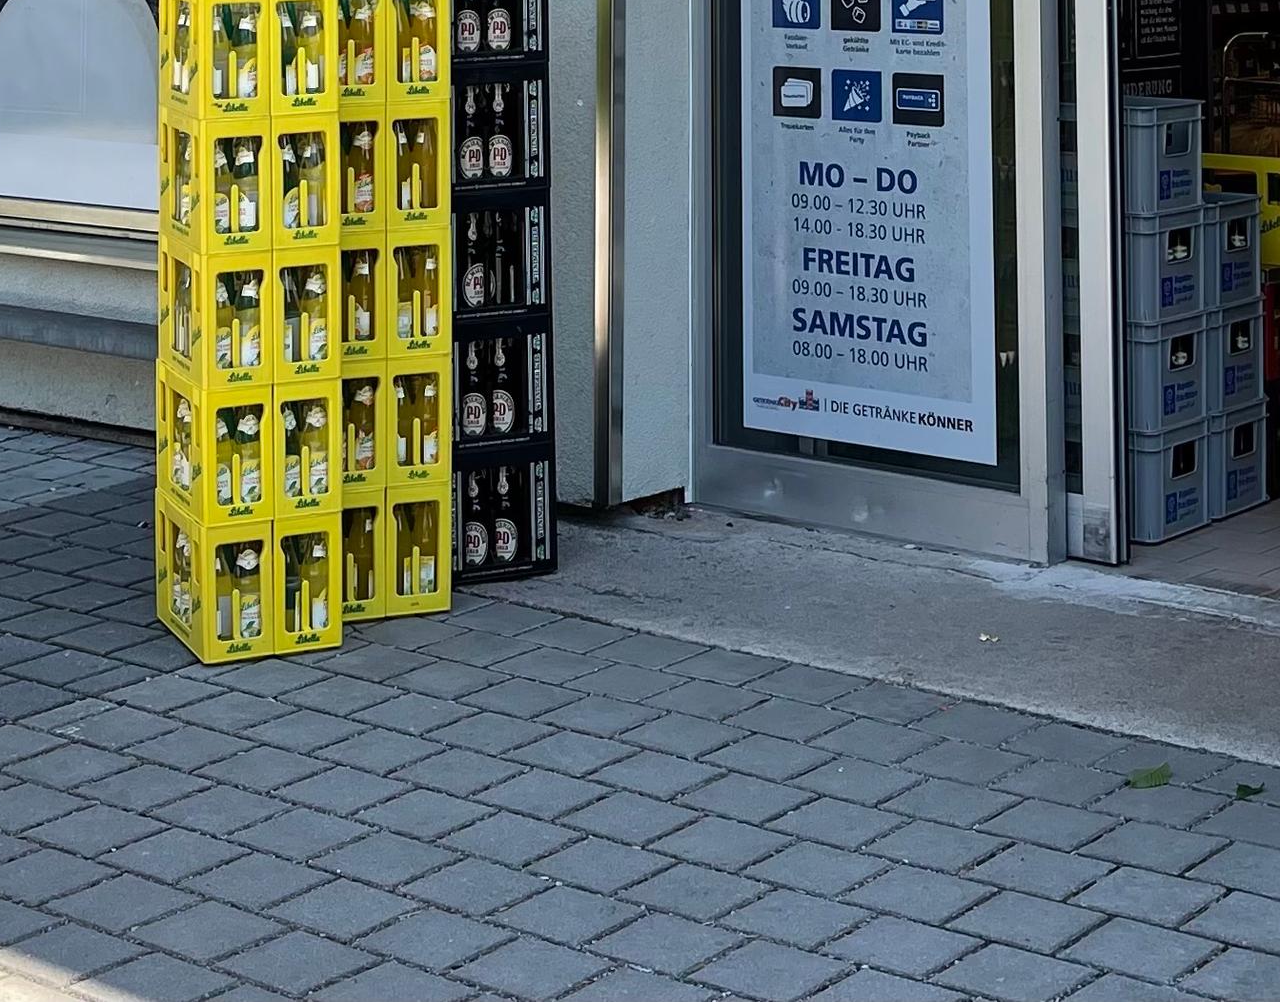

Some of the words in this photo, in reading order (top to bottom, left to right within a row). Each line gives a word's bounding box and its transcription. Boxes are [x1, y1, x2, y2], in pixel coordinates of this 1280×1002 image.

[341, 86, 365, 97] Libella
[406, 84, 430, 95] Libella
[223, 102, 249, 113] Libella
[292, 97, 318, 107] Libella
[799, 160, 845, 188] MO
[876, 167, 918, 195] DO
[791, 193, 831, 211] 09.00
[848, 198, 888, 217] 12.30
[892, 202, 927, 220] UHR
[342, 216, 368, 226] Libella
[404, 211, 428, 221] Libella
[292, 229, 318, 240] Libella
[793, 216, 832, 235] 14.00
[848, 222, 887, 241] 18.30
[892, 226, 926, 244] UHR
[224, 235, 250, 246] Libella
[802, 247, 915, 283] FREITAG
[792, 278, 832, 298] 09.00
[849, 285, 889, 304] 18.30
[893, 290, 928, 309] UHR
[792, 307, 928, 347] SAMSTAG
[406, 340, 431, 349] Libella
[344, 346, 368, 356] Libella
[793, 340, 833, 359] 08.00
[849, 348, 889, 367] 18.00
[894, 353, 929, 373] UHR
[294, 364, 321, 375] Libella
[227, 371, 253, 383] Libella
[830, 400, 849, 415] DIE
[852, 403, 916, 424] GETRÄNKE
[918, 412, 973, 432] KÖNNER
[343, 474, 367, 484] Libella
[295, 498, 322, 509] Libella
[228, 506, 254, 518] Libella
[342, 603, 366, 614] Libella
[295, 634, 321, 644] Libella
[226, 643, 252, 653] Libella
